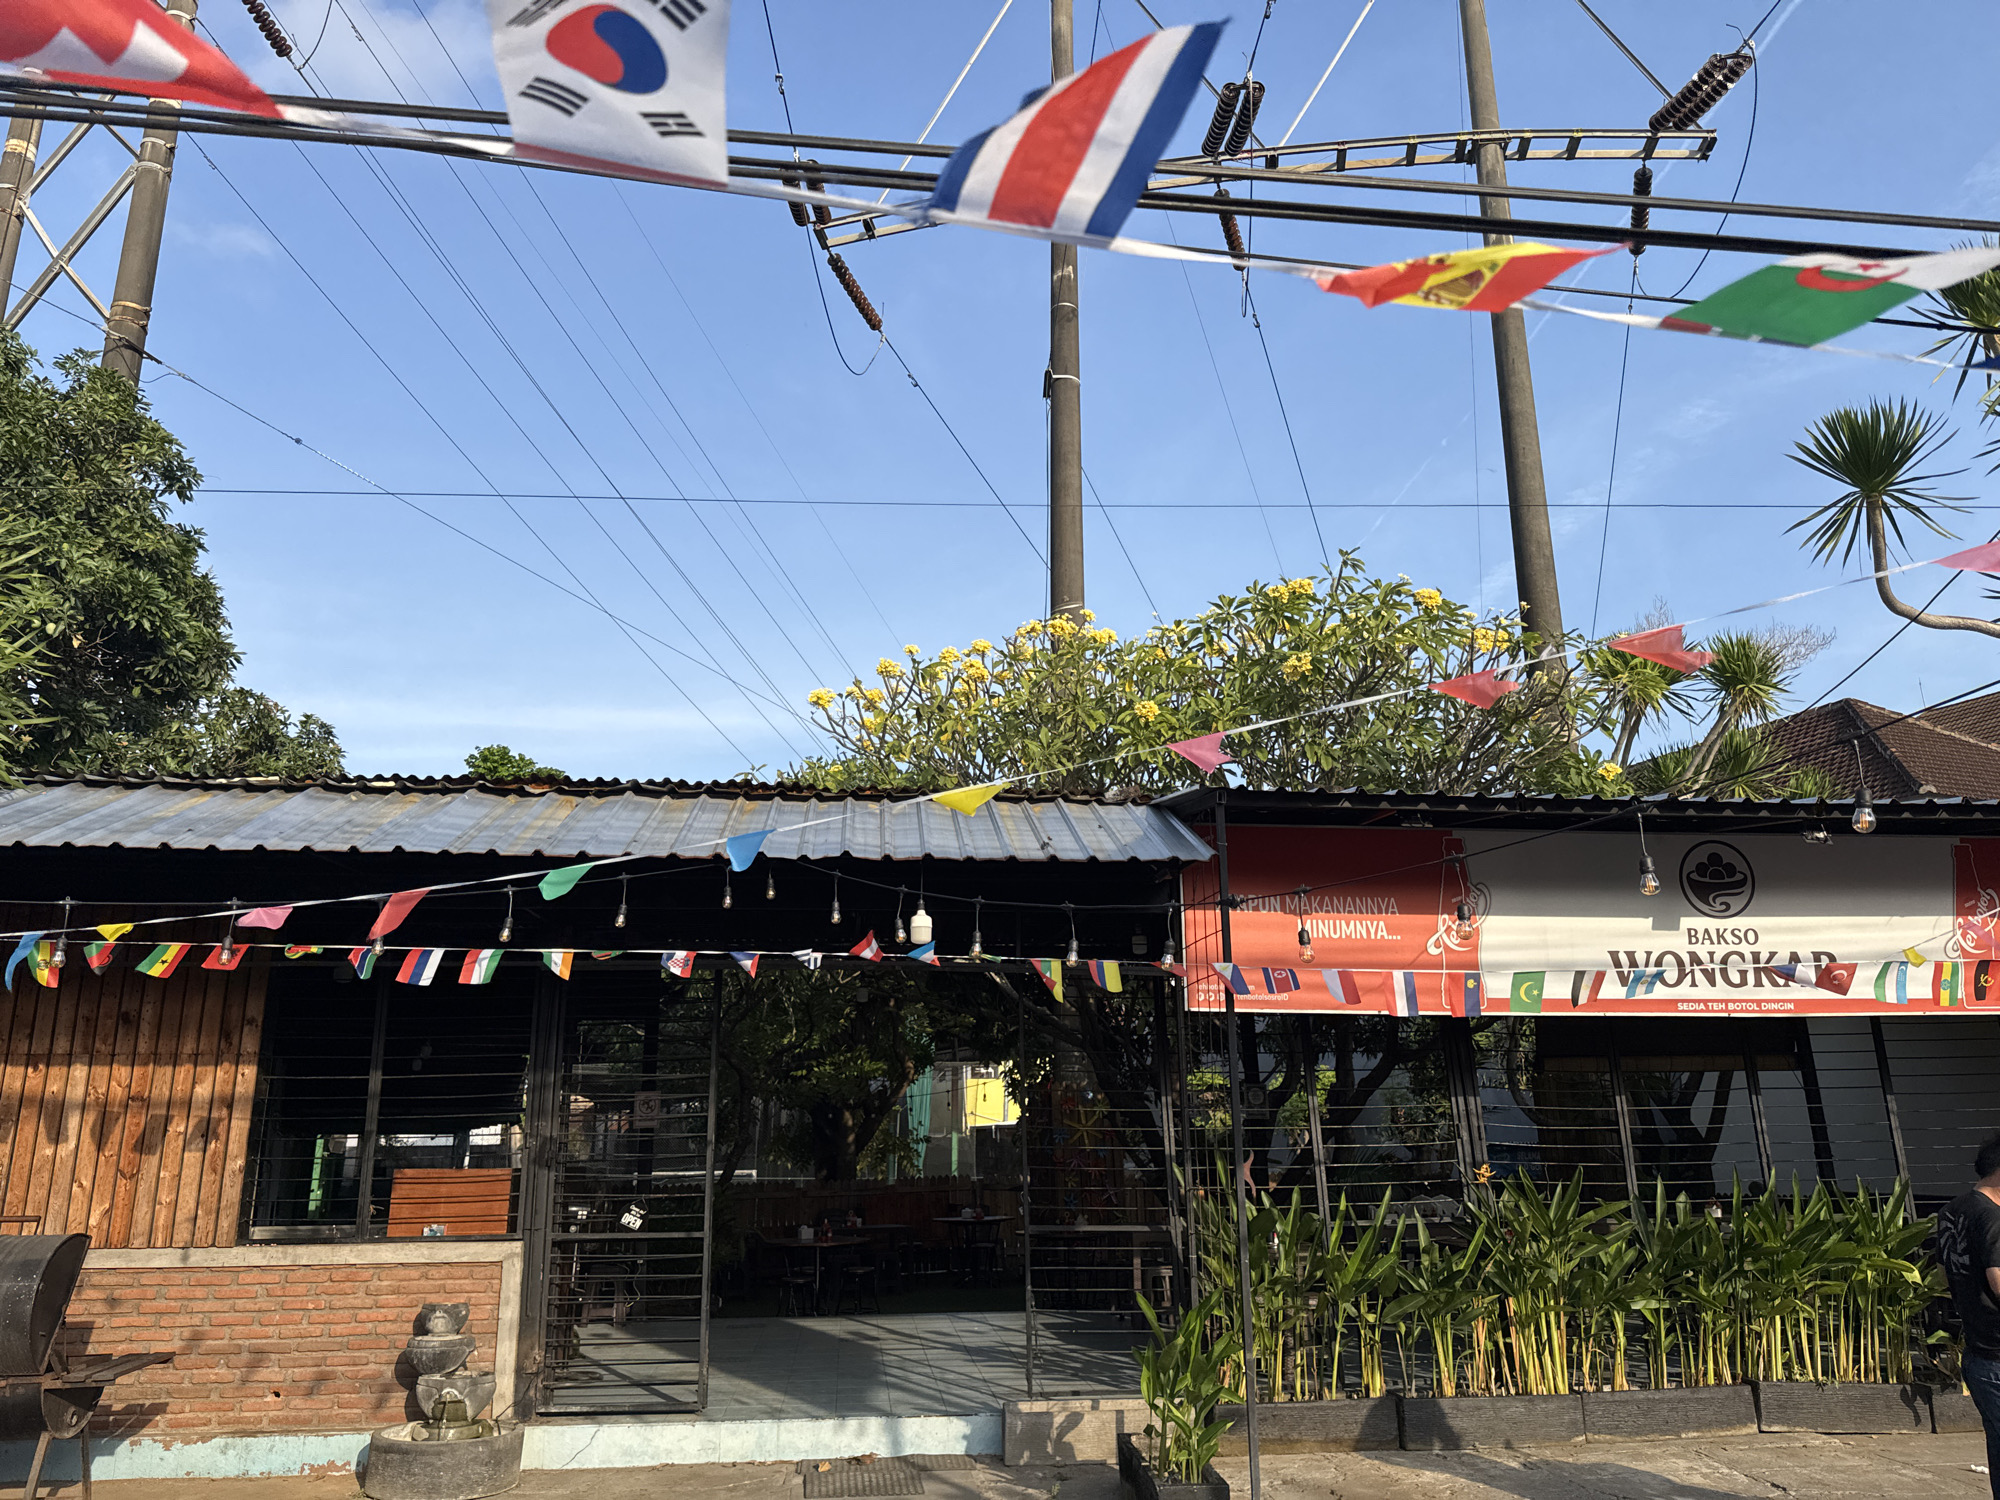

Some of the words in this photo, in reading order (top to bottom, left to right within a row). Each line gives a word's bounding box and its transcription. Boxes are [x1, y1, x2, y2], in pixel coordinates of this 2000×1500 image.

[1285, 894, 1400, 915] MAKANANNYA
[1297, 918, 1401, 940] MINUMNYA...
[1687, 928, 1759, 946] BAKSO
[1677, 1002, 1706, 1010] SEDIA
[1707, 1002, 1726, 1010] TEH
[1728, 1002, 1760, 1010] BOTOL
[1761, 1002, 1795, 1011] DINGIN
[621, 1212, 644, 1230] OPEN
